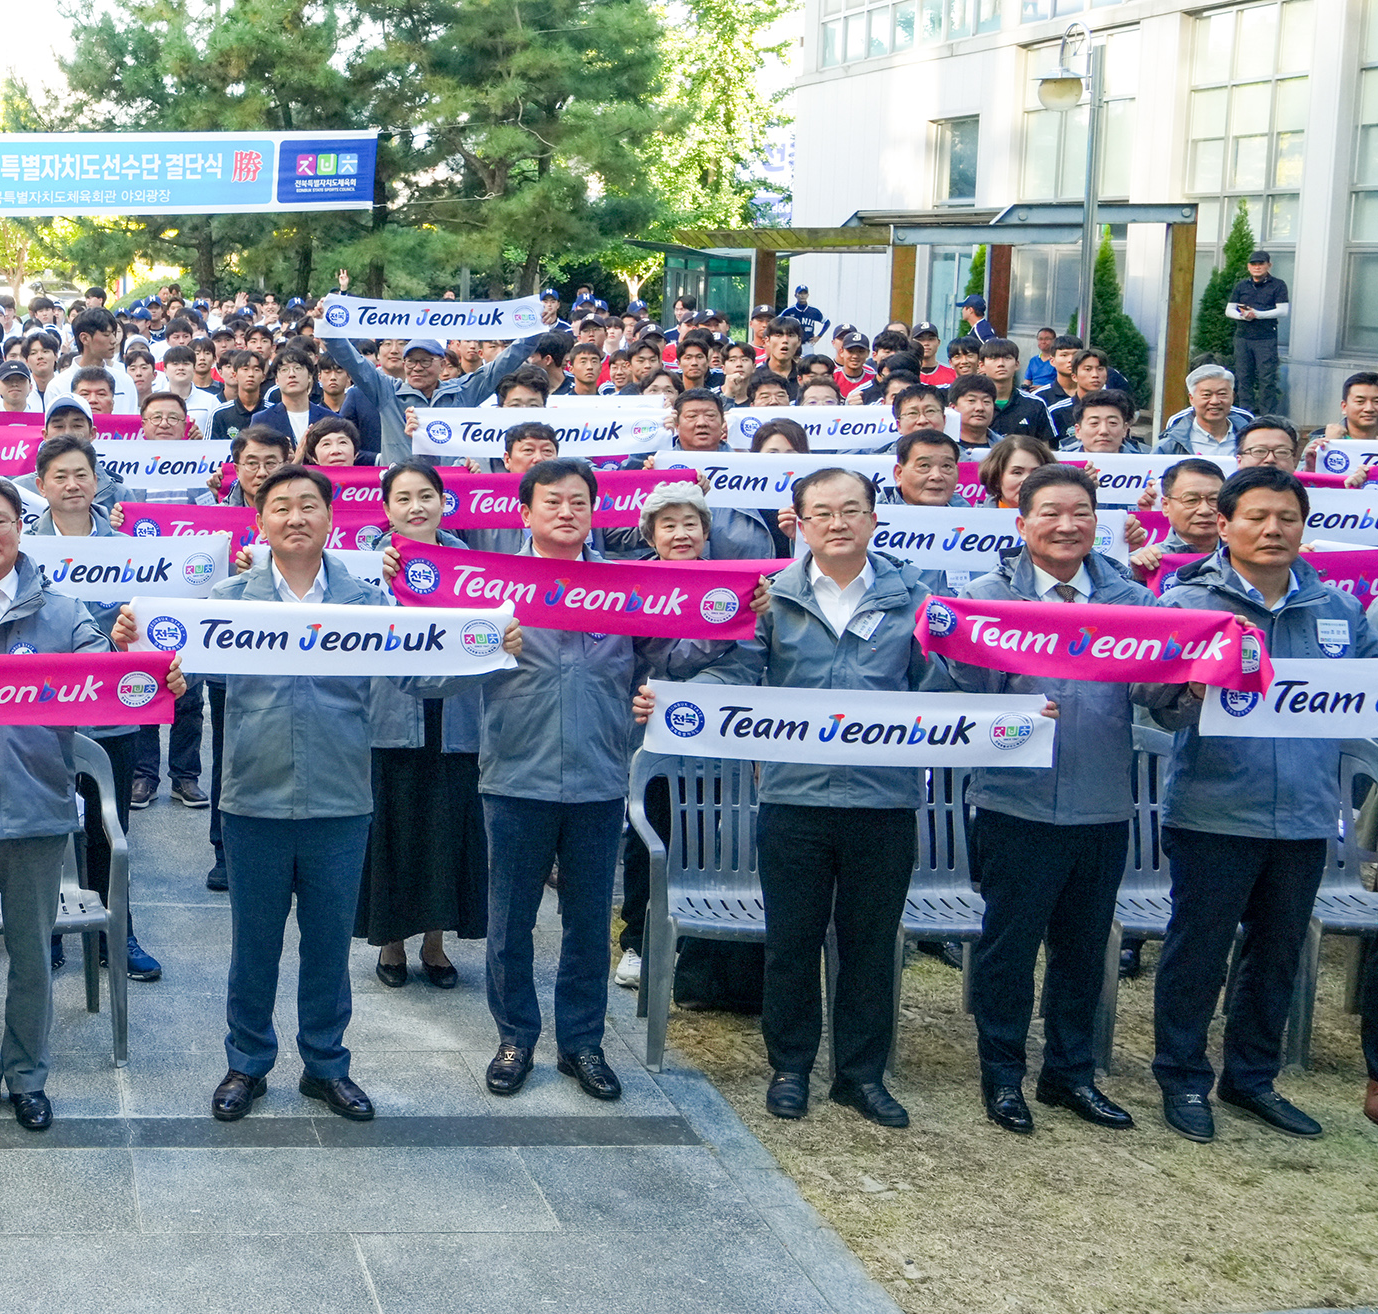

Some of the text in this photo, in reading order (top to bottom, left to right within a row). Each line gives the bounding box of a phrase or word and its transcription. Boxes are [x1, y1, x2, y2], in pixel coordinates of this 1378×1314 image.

[165, 152, 223, 179] 결단식
[231, 150, 262, 183] 勝
[121, 188, 171, 203] 야외광장
[357, 306, 504, 327] Team Jeonbuk
[554, 421, 623, 443] onbuk
[828, 418, 899, 437] Jeonbu
[704, 466, 769, 492] Team
[53, 557, 173, 584] Jeonbuk
[410, 569, 434, 584] 전북
[453, 564, 537, 603] Team
[544, 578, 689, 616] Jeonbuk
[155, 626, 180, 641] 전북
[199, 618, 289, 652] Team
[298, 623, 448, 652] Jeonbuk
[965, 614, 1233, 663] Team Jeonbuk
[1274, 680, 1366, 714] Team
[672, 712, 698, 727] 전북
[719, 706, 809, 741] Team
[818, 714, 977, 746] Jeonbuk
